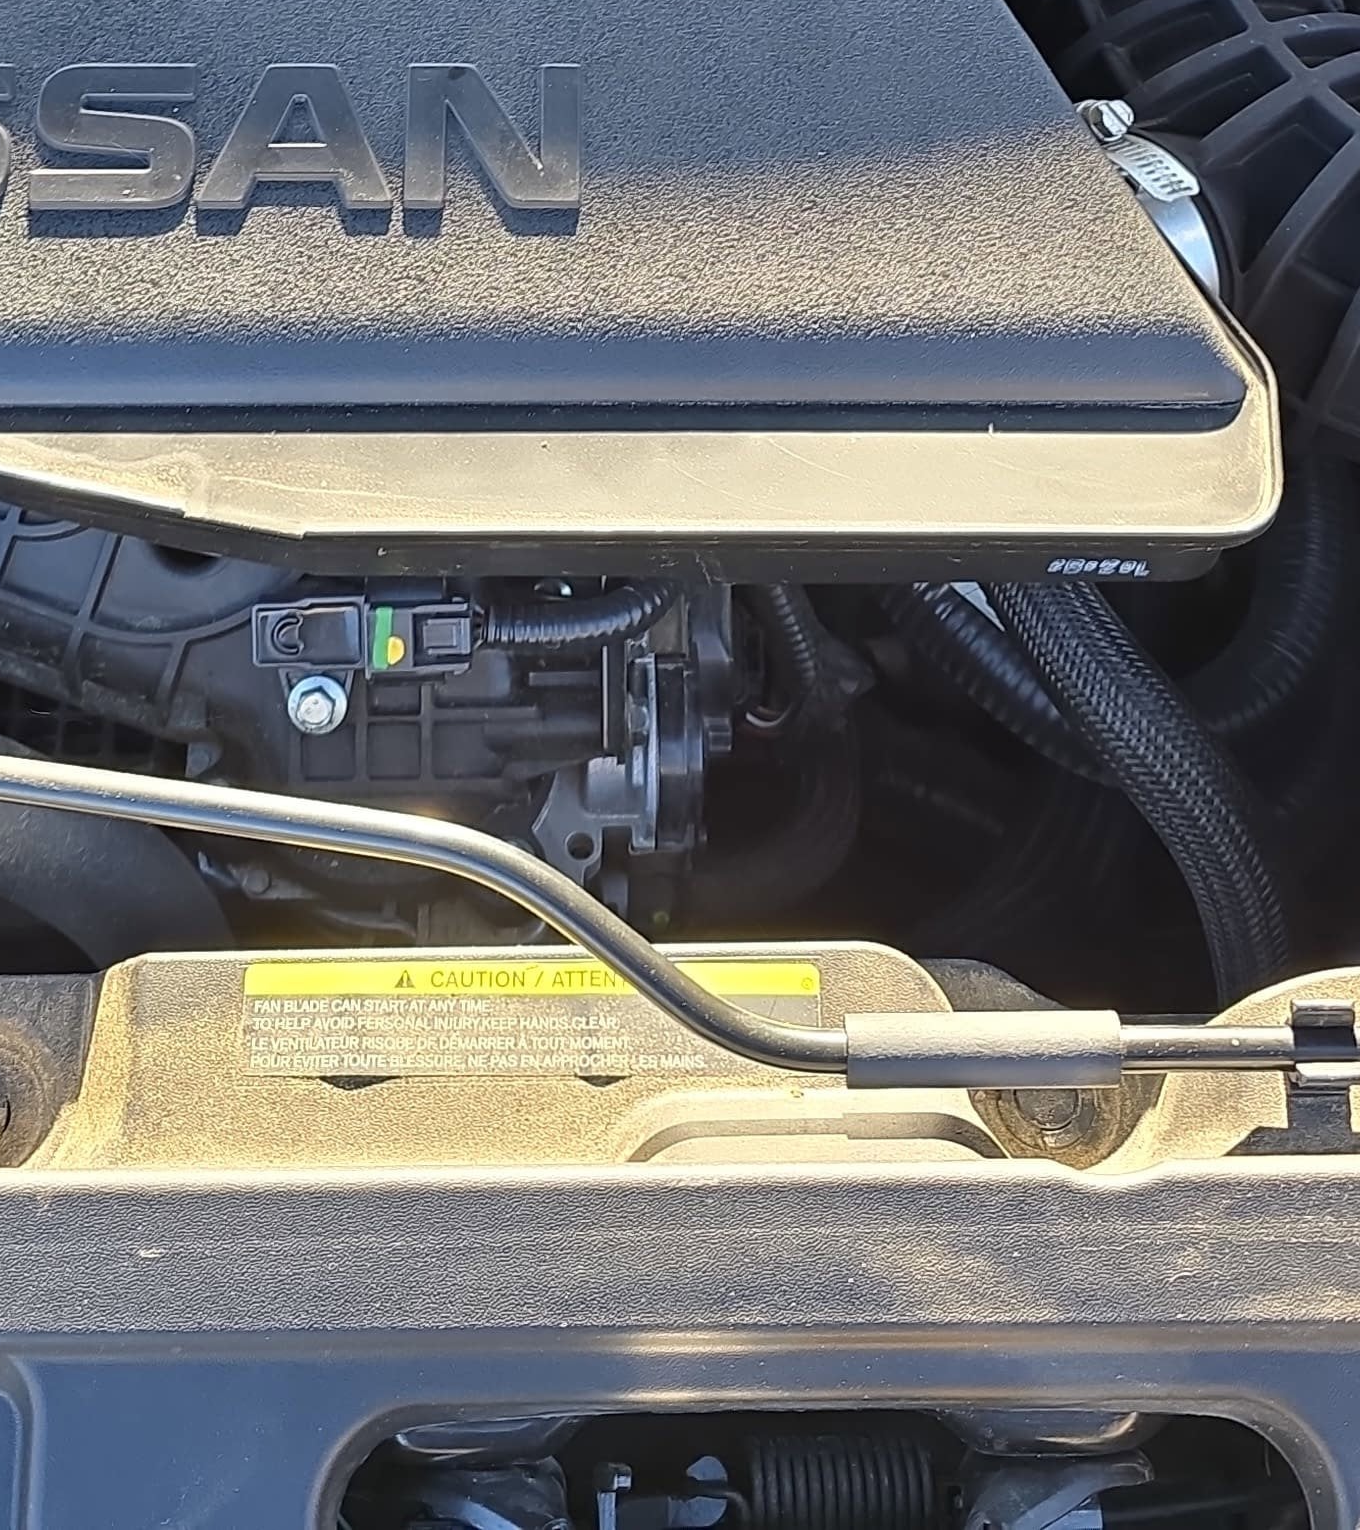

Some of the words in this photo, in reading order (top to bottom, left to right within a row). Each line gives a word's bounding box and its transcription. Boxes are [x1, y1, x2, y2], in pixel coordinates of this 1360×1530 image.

[430, 971, 525, 988] CAUTION
[535, 971, 544, 988] /
[552, 970, 625, 988] ATTEN
[254, 999, 281, 1013] FAN
[283, 999, 329, 1013] BLADE
[331, 999, 361, 1013] CAN
[363, 999, 405, 1013] START
[407, 999, 427, 1013] AT
[428, 999, 456, 1013] ANY
[252, 1017, 271, 1030] TO
[274, 1017, 311, 1030] HELP
[313, 1017, 356, 1030] AVOID
[357, 1017, 432, 1030] PERSONAL
[482, 1017, 518, 1030] KEEP
[519, 1017, 568, 1030] HANDS
[251, 1037, 268, 1050] LE
[270, 1037, 359, 1050] VENTILATEUR
[362, 1037, 414, 1050] RISQUE
[439, 1032, 515, 1050] DÉMARRER
[532, 1037, 566, 1050] TOUT
[250, 1055, 293, 1068] POUR
[294, 1051, 339, 1068] ÉVITER
[341, 1055, 386, 1068] TOUTE
[468, 1055, 488, 1068] NE
[490, 1055, 518, 1068] PAS
[520, 1055, 539, 1068] EN
[540, 1055, 630, 1068] APPROCHER
[631, 1054, 657, 1069] LES
